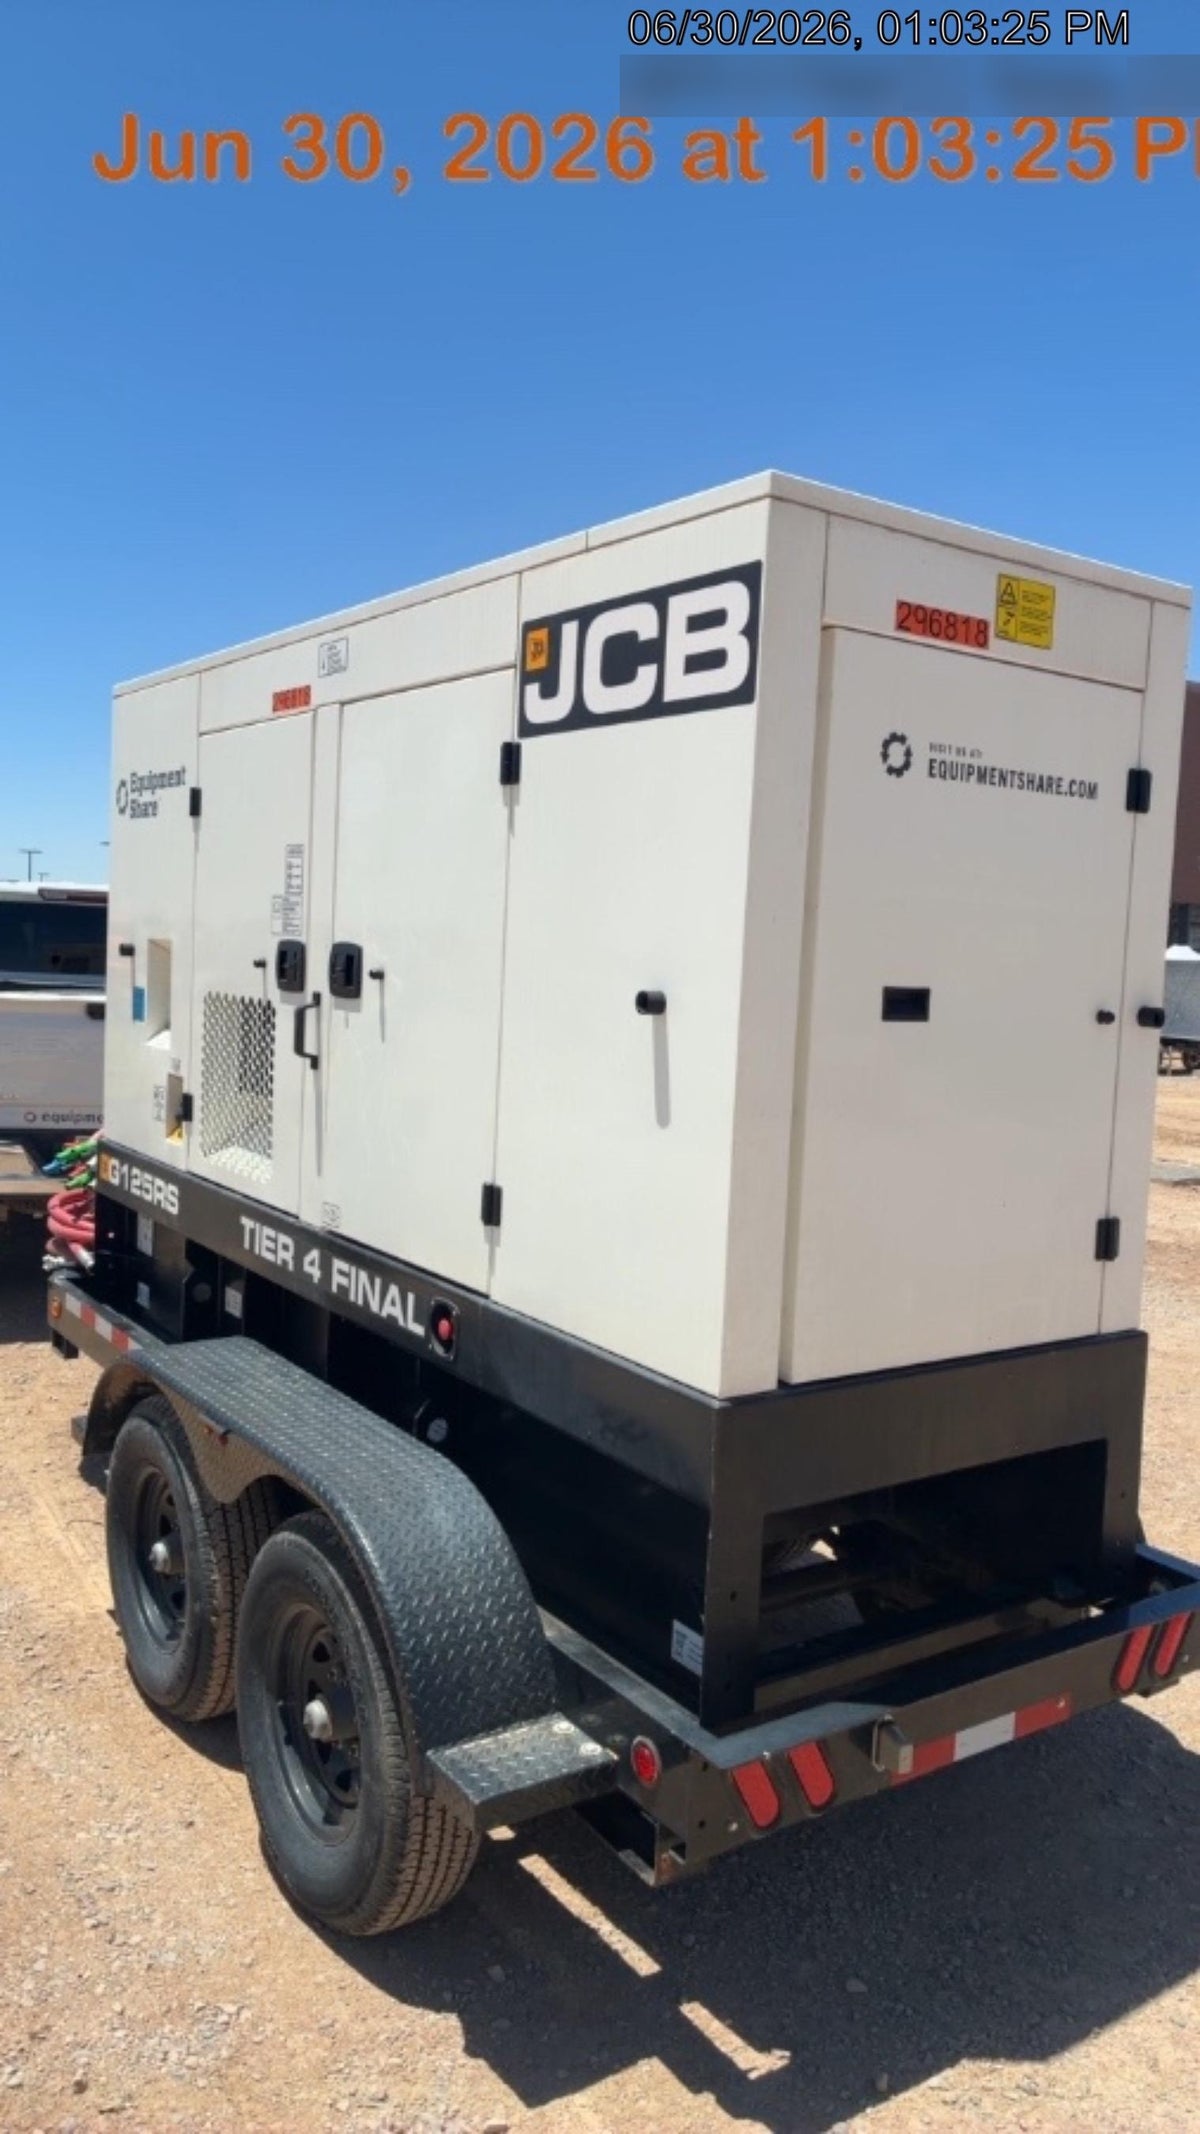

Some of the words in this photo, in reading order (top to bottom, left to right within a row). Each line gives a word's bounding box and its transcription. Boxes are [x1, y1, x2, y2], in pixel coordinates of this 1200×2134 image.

[896, 601, 989, 648] 296818
[524, 580, 750, 725] JCB
[130, 765, 186, 797] Equipment
[928, 758, 1099, 800] EQUIPMENTSHARE.COM
[130, 798, 158, 819] Share
[239, 1216, 295, 1272] TIER
[303, 1249, 322, 1284] 4
[331, 1257, 426, 1337] FINAL
